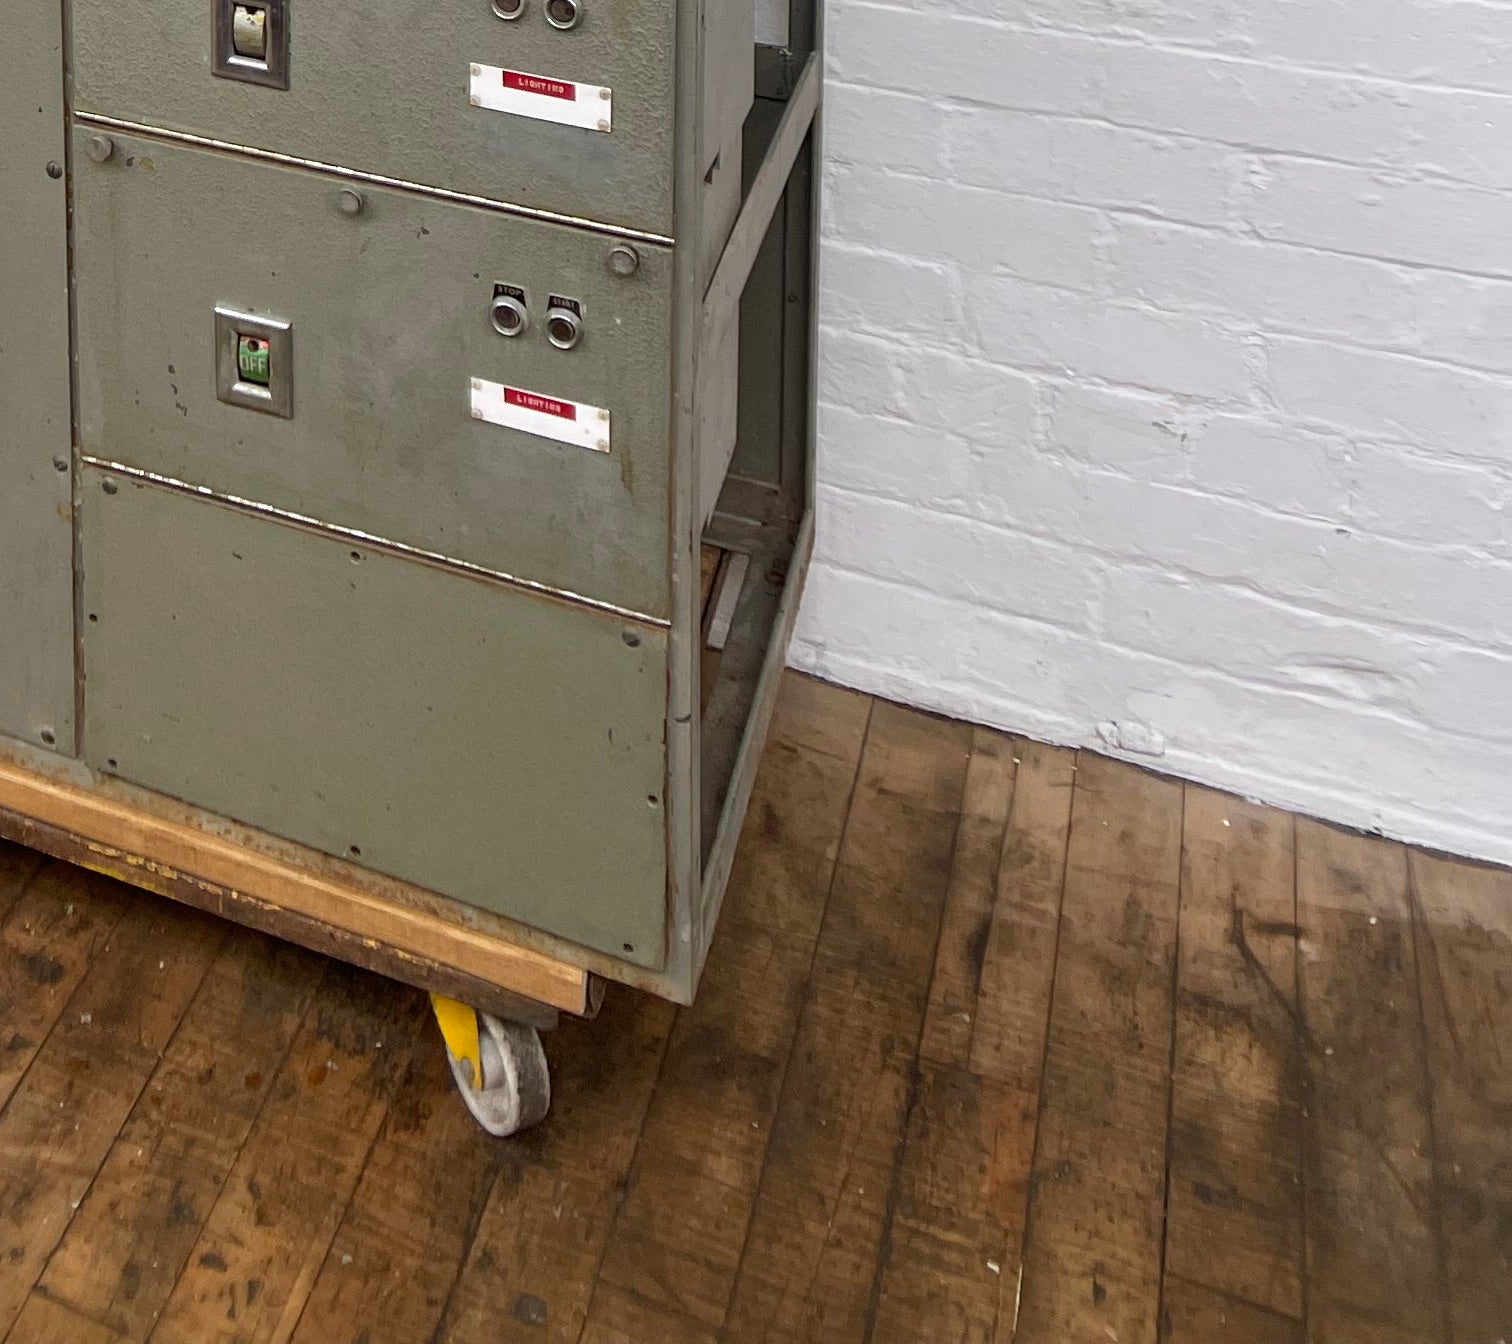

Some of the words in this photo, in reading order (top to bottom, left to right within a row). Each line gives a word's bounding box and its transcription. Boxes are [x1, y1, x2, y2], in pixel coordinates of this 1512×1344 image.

[518, 78, 564, 94] LIGHTING
[497, 286, 521, 296] STOP
[553, 297, 577, 309] START
[240, 355, 267, 374] OFF
[517, 394, 562, 413] LIGHTING
